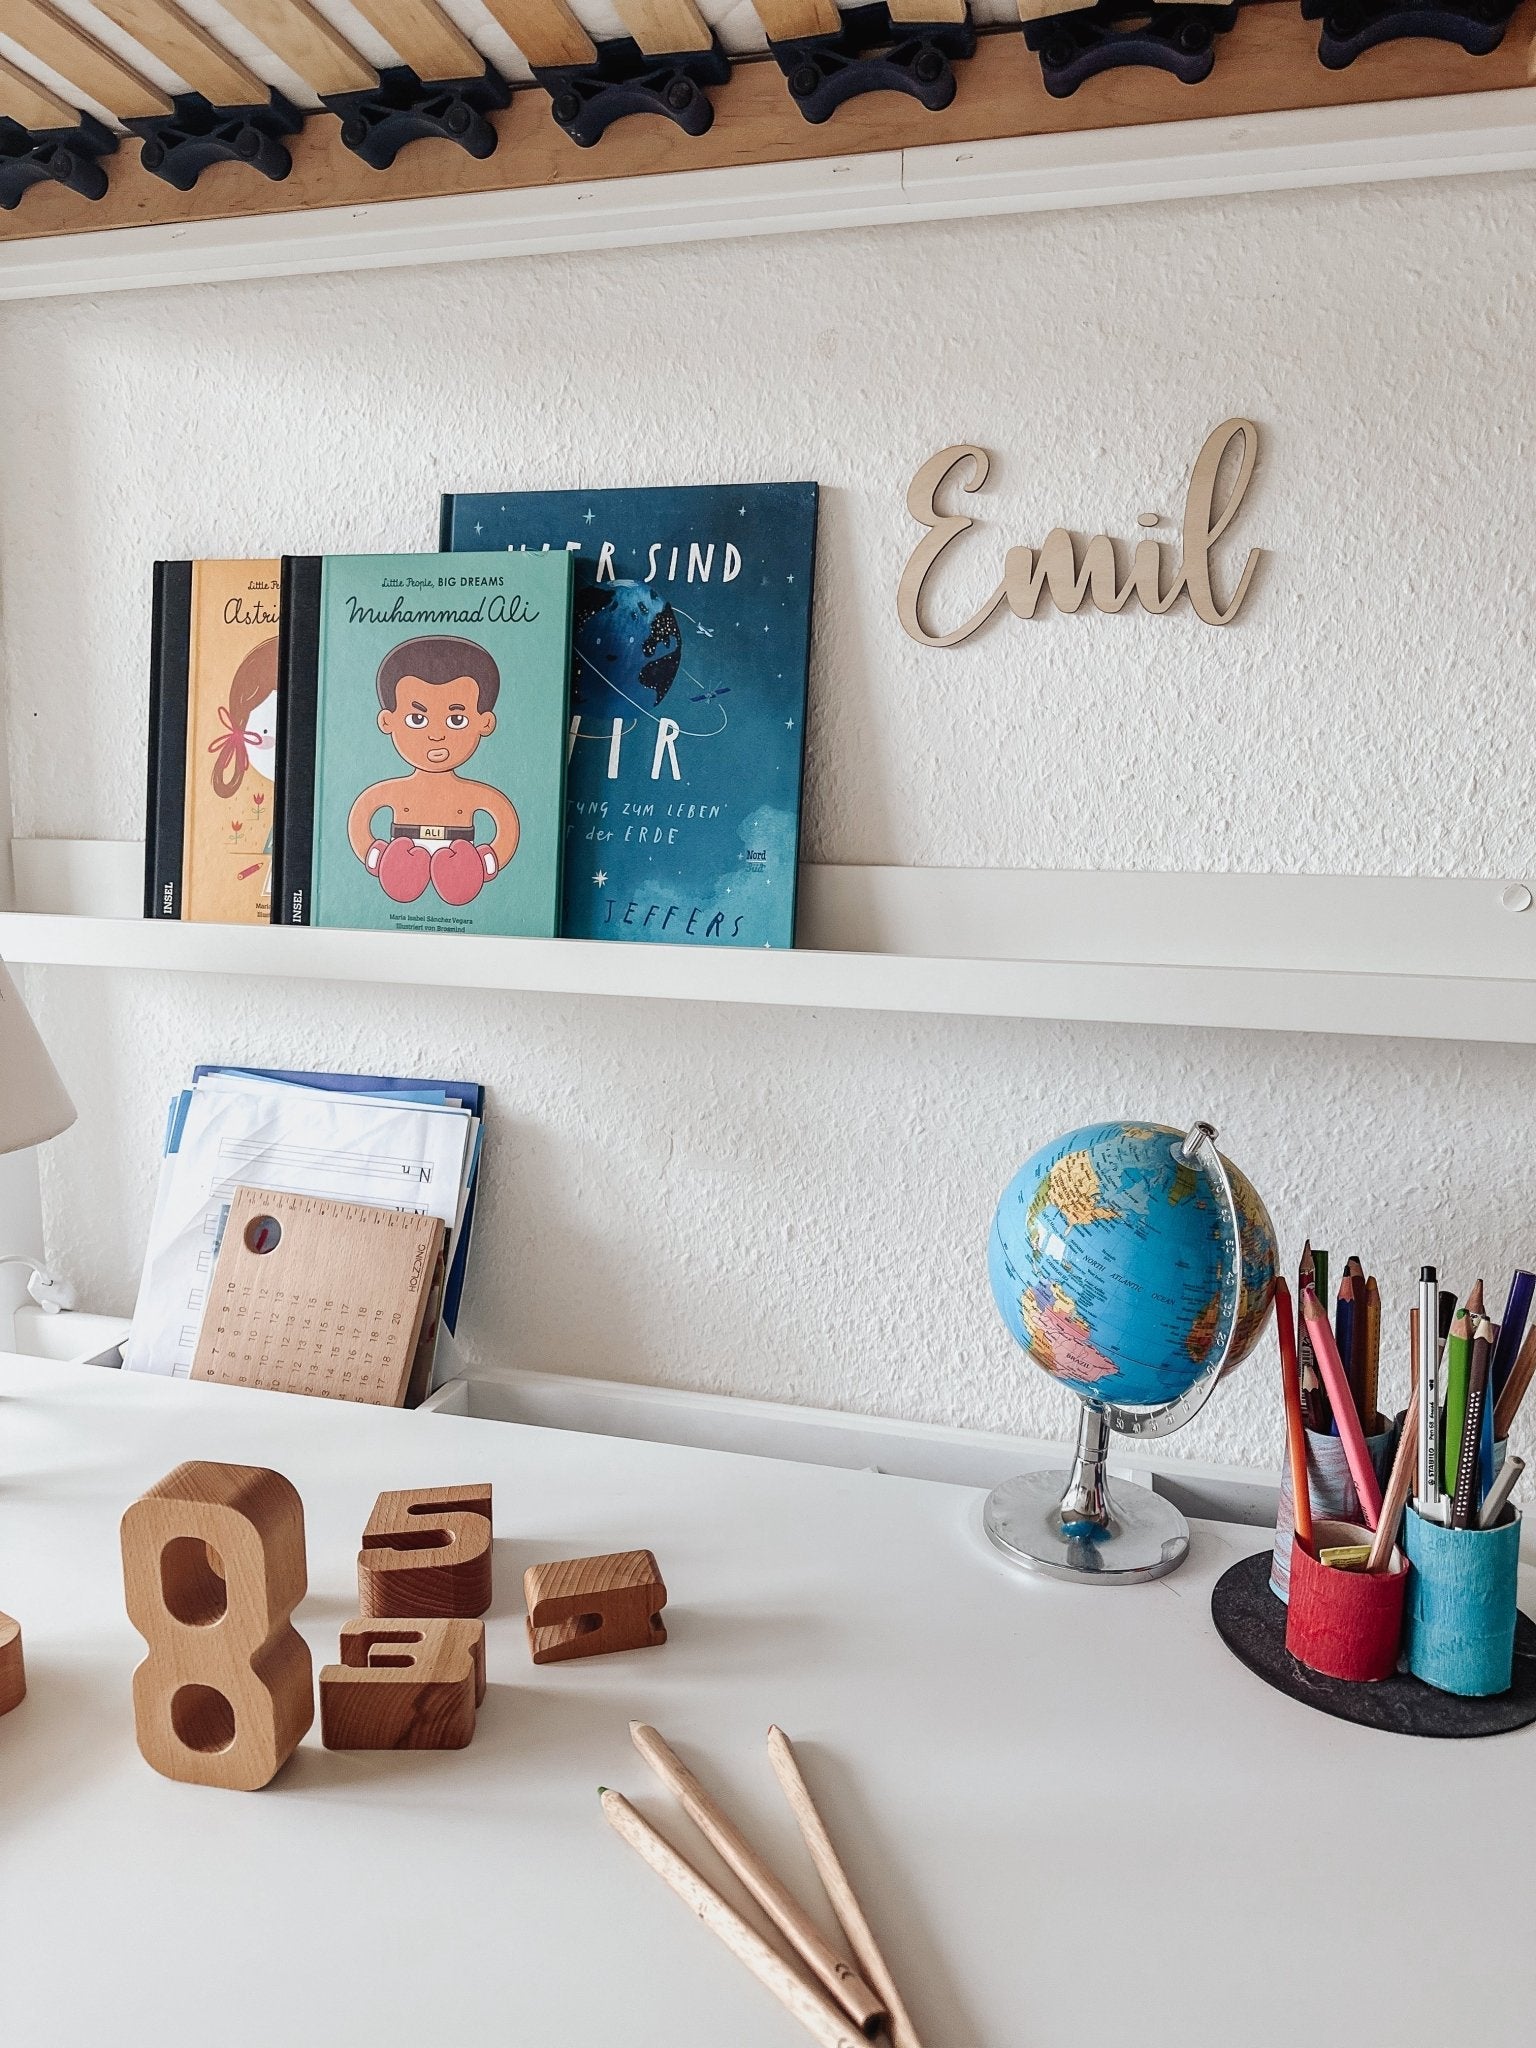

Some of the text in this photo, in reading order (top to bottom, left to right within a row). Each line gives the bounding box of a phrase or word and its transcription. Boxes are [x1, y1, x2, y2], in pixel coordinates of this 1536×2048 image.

[897, 418, 1262, 647] Emil
[645, 542, 742, 583] SIND
[381, 577, 404, 588] Little
[438, 577, 456, 586] BIG
[460, 577, 504, 586] DREAMS
[224, 598, 280, 625] Astri
[346, 595, 540, 623] Muhammad Ali
[667, 804, 720, 819] LEBEN
[424, 828, 440, 837] ALI
[586, 827, 614, 842] der
[625, 825, 679, 845] ERDE
[746, 850, 767, 860] Nord
[163, 882, 174, 914] INSEL
[293, 890, 303, 923] INSEL
[604, 899, 744, 938] JEFFERS
[419, 1167, 431, 1183] N
[227, 1283, 236, 1293] 10
[1082, 1255, 1106, 1272] NORTH
[1110, 1272, 1145, 1293] ATLANTIC
[1151, 1292, 1176, 1305] OCEAN
[238, 1306, 246, 1317] 10
[243, 1287, 251, 1296] 11
[249, 1330, 258, 1341] 10
[254, 1311, 262, 1320] 11
[259, 1289, 268, 1299] 12
[259, 1355, 269, 1366] 10
[264, 1336, 273, 1345] 11
[270, 1312, 279, 1323] 12
[275, 1291, 284, 1302] 13
[276, 1360, 285, 1369] 11
[281, 1337, 291, 1347] 12
[286, 1316, 295, 1327] 13
[291, 1295, 299, 1305] 14
[292, 1361, 302, 1372] 12
[297, 1340, 307, 1351] 13
[302, 1319, 311, 1329] 14
[308, 1298, 317, 1308] 15
[308, 1365, 318, 1376] 13
[314, 1343, 322, 1354] 14
[319, 1322, 328, 1333] 15
[324, 1301, 333, 1311] 16
[325, 1368, 334, 1379] 14
[331, 1346, 340, 1357] 15
[336, 1325, 345, 1336] 16
[341, 1303, 349, 1314] 17
[342, 1371, 352, 1382] 15
[347, 1349, 357, 1360] 16
[352, 1328, 362, 1339] 17
[358, 1306, 367, 1317] 18
[359, 1375, 369, 1385] 16
[364, 1353, 373, 1364] 17
[370, 1331, 379, 1342] 18
[375, 1310, 384, 1321] 19
[377, 1313, 401, 1389] 17 18 19 20
[1066, 1353, 1090, 1369] BRAZIL
[120, 1462, 312, 1791] 8
